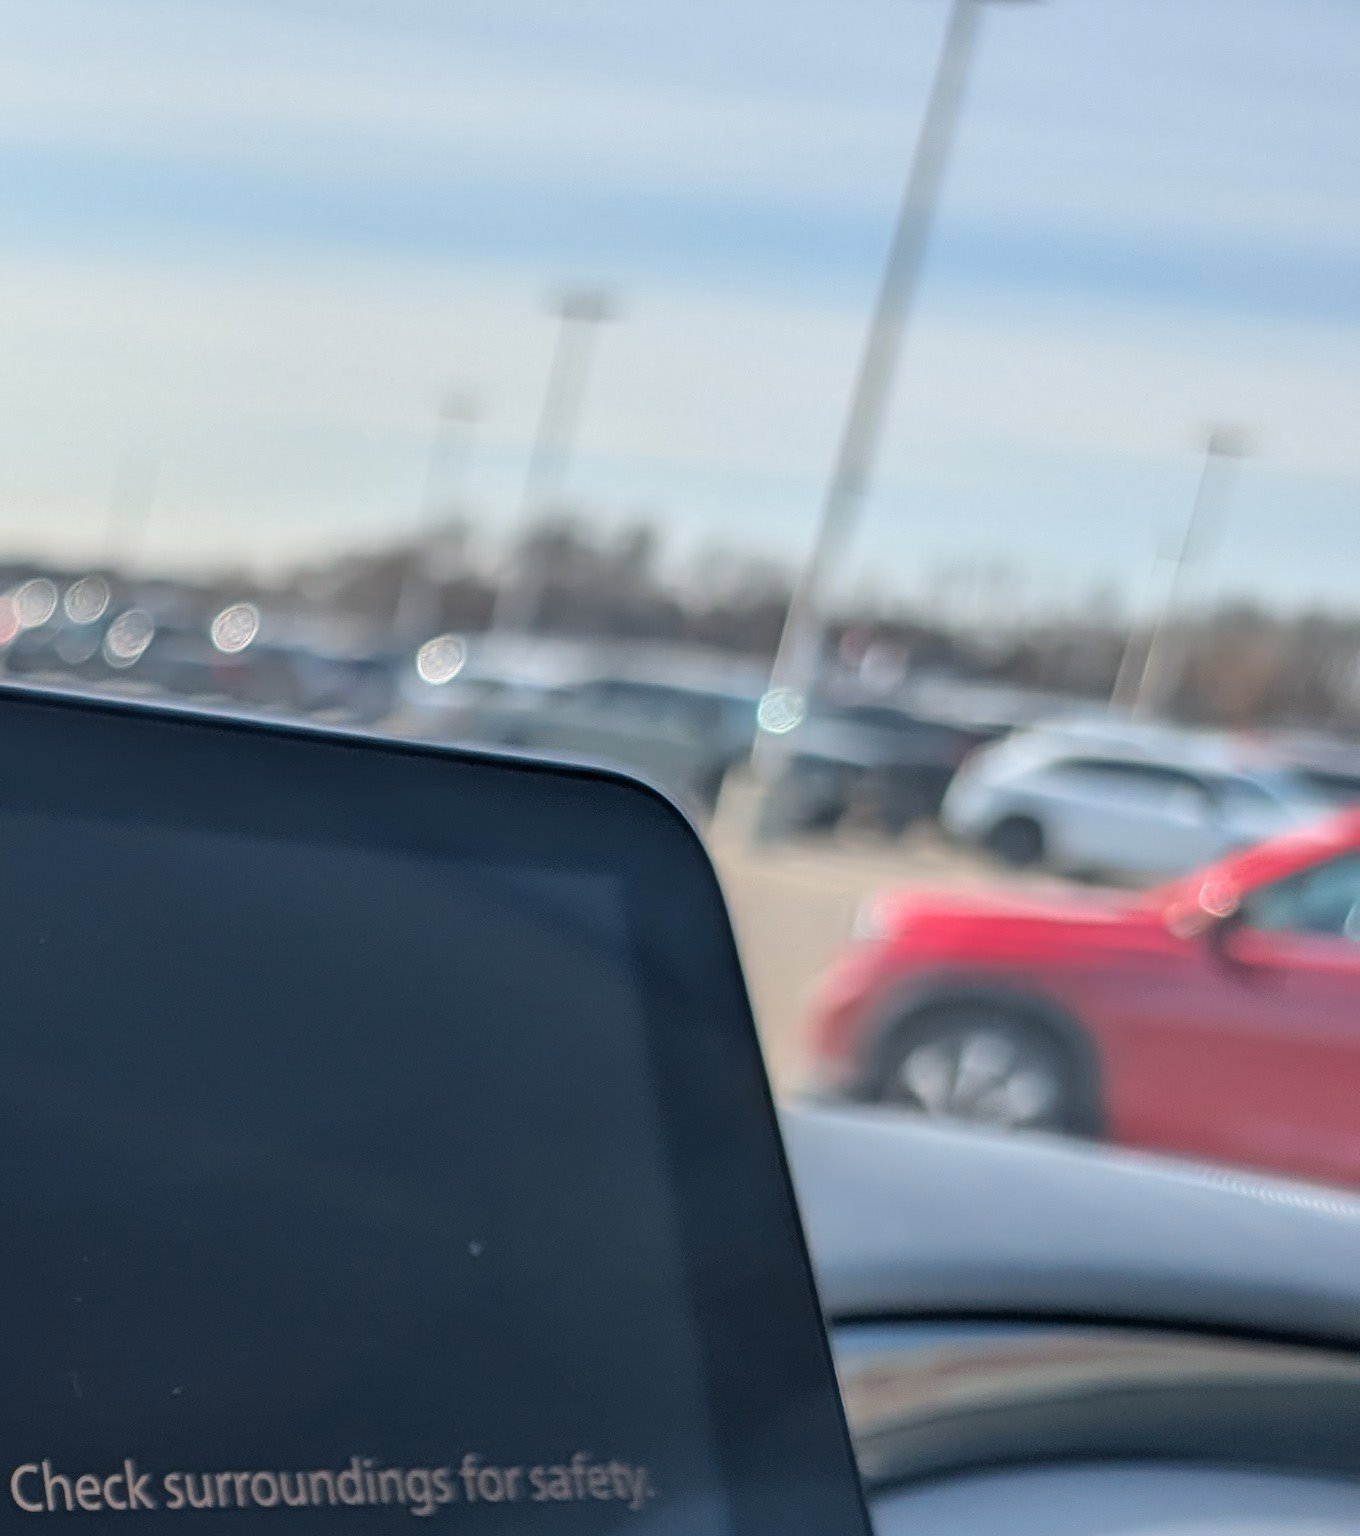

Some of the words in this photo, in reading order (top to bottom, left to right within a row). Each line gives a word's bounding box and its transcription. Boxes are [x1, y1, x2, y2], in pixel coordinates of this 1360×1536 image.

[10, 1459, 155, 1514] Check
[163, 1455, 451, 1517] surroundings
[458, 1453, 520, 1502] for
[529, 1452, 658, 1510] safety.
